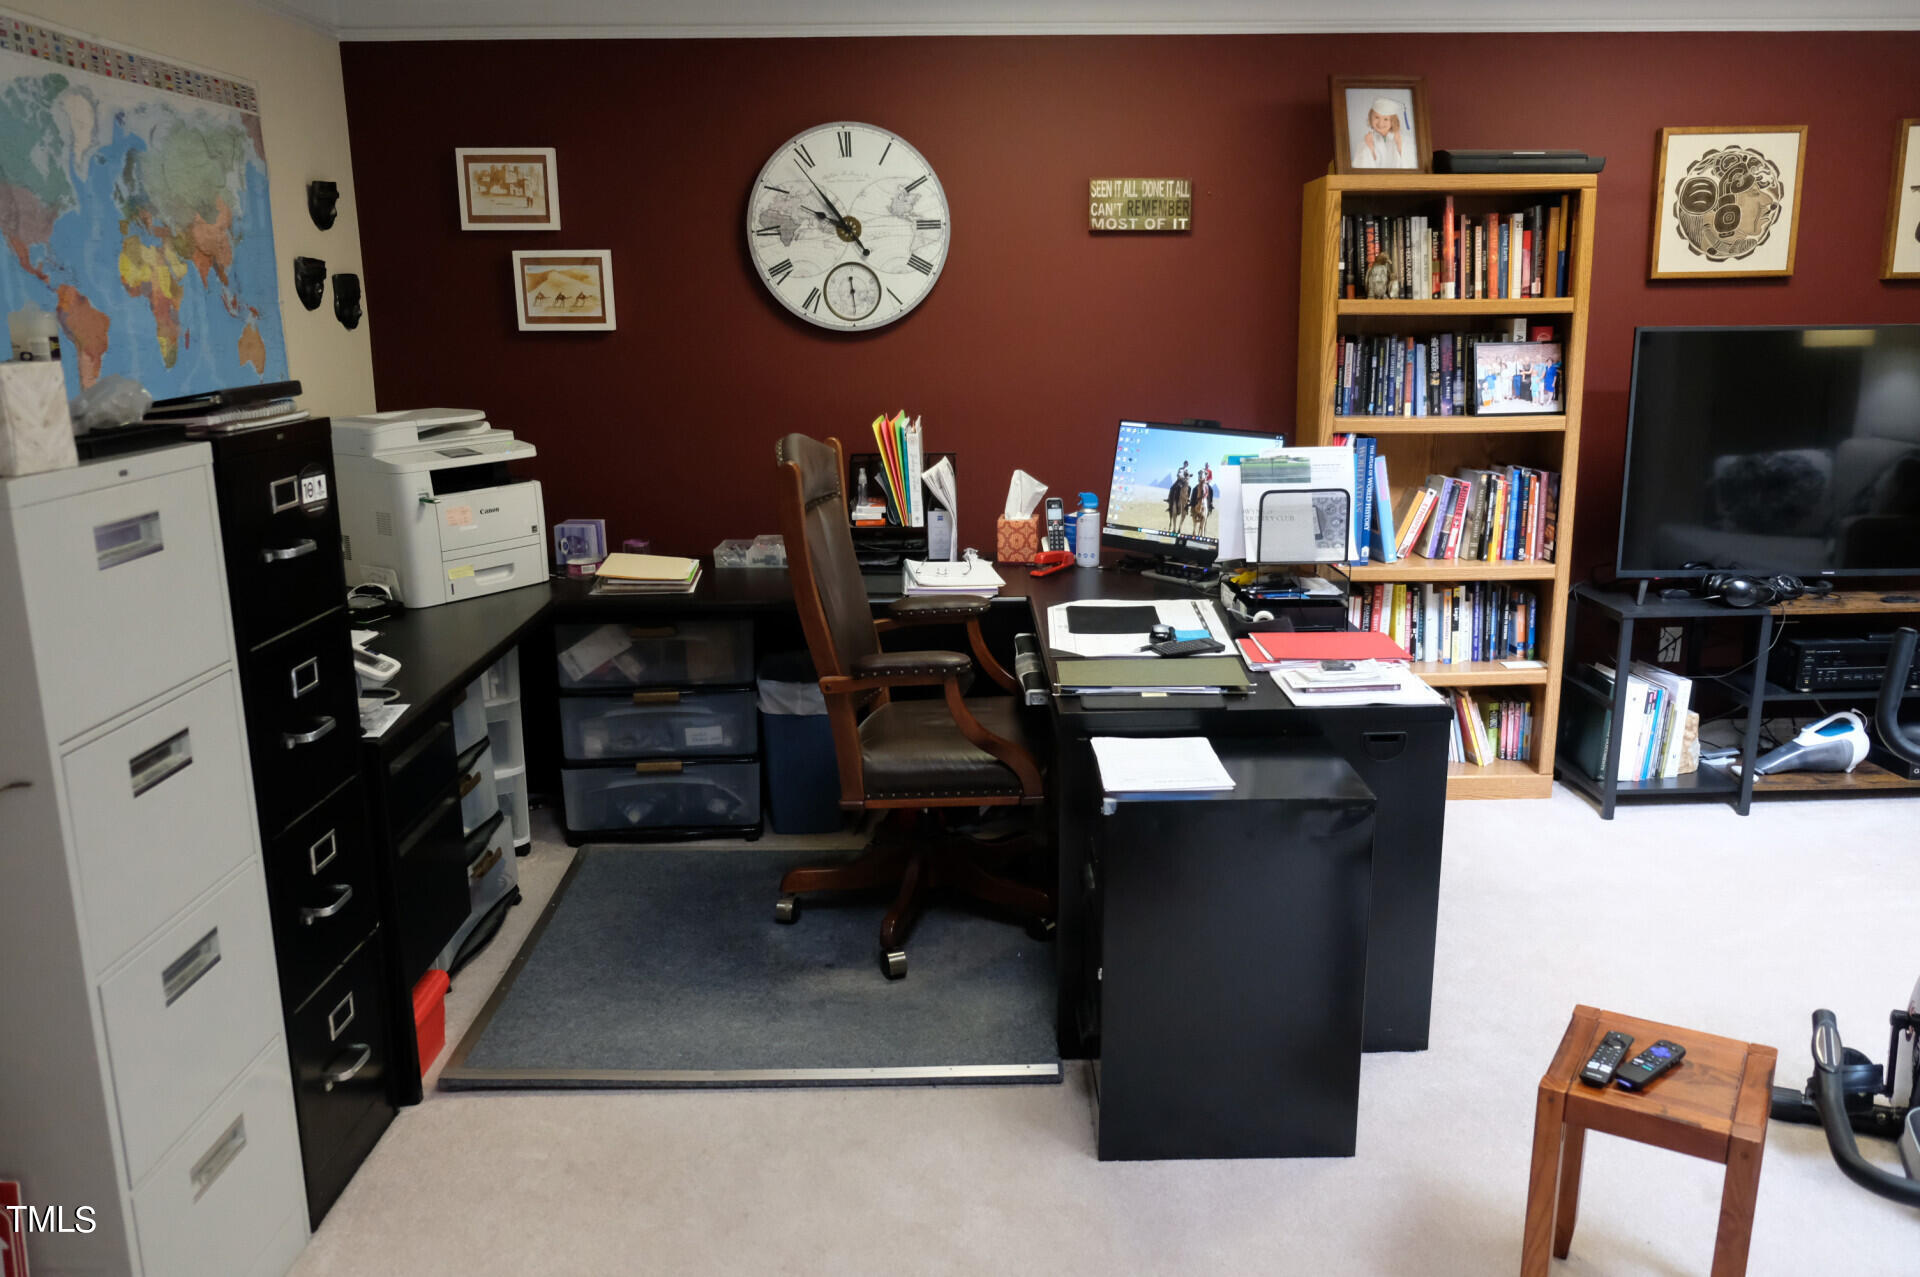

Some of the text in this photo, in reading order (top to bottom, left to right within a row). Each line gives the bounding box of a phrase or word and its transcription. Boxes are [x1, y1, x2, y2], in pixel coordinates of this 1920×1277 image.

[1090, 180, 1190, 198] SEEN IT ALL DONE IT ALL
[1090, 199, 1190, 217] CAN'T REMEMBER
[1091, 218, 1189, 230] MOST OF IT
[479, 507, 500, 515] Canon
[1364, 503, 1372, 531] HISTORY
